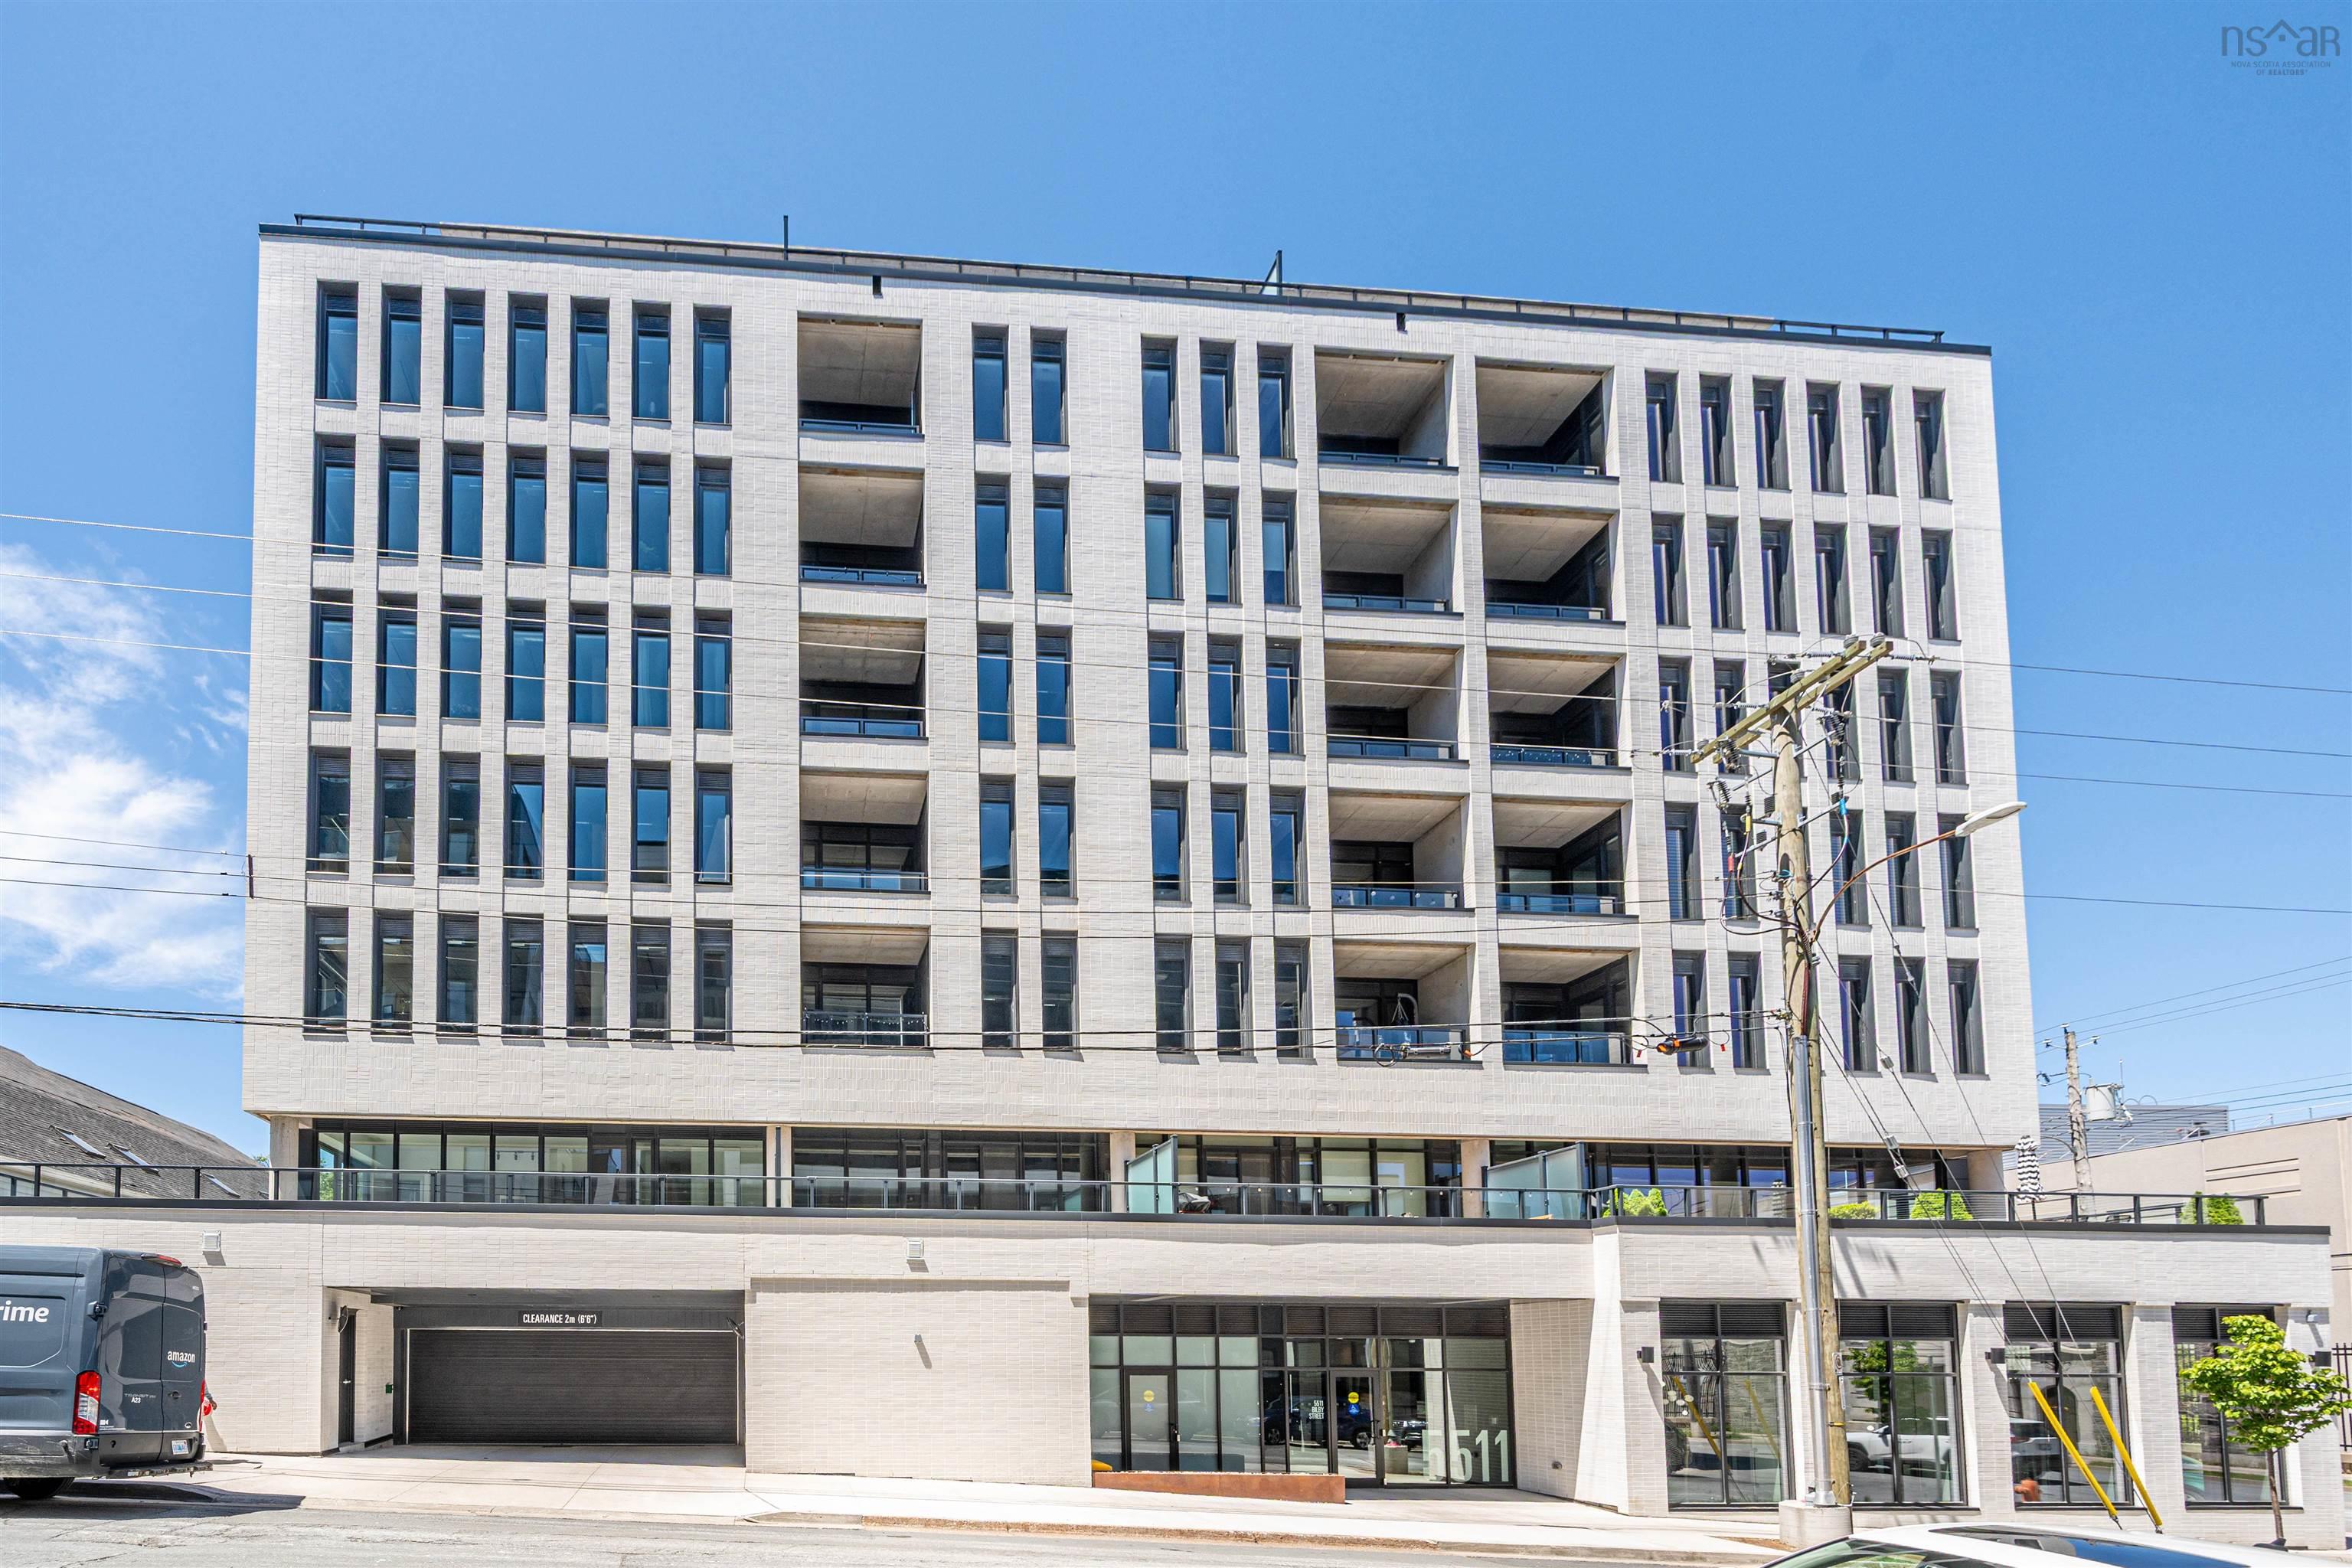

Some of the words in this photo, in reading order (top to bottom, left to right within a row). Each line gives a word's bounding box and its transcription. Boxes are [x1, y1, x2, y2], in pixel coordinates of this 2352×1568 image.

[523, 1314, 563, 1324] CLEARANCE
[565, 1315, 575, 1324] 2m
[577, 1314, 597, 1324] (6'6")
[167, 1351, 195, 1363] amazon
[1422, 1429, 1509, 1483] 5511
